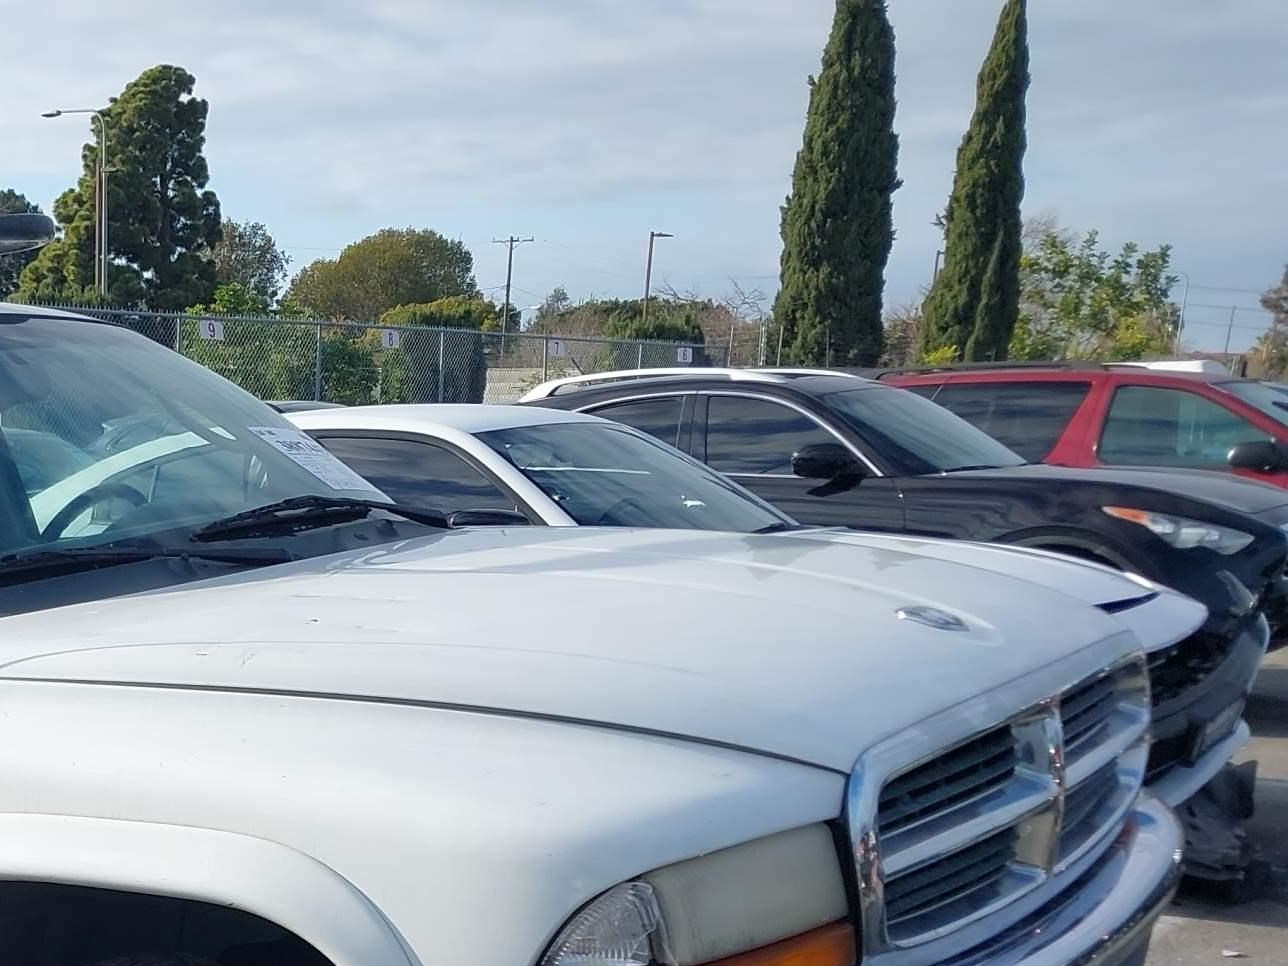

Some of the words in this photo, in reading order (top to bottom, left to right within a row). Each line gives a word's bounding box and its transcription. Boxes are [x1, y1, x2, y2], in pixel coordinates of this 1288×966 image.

[207, 322, 216, 339] 9
[388, 331, 395, 347] 8
[554, 341, 560, 355] 7
